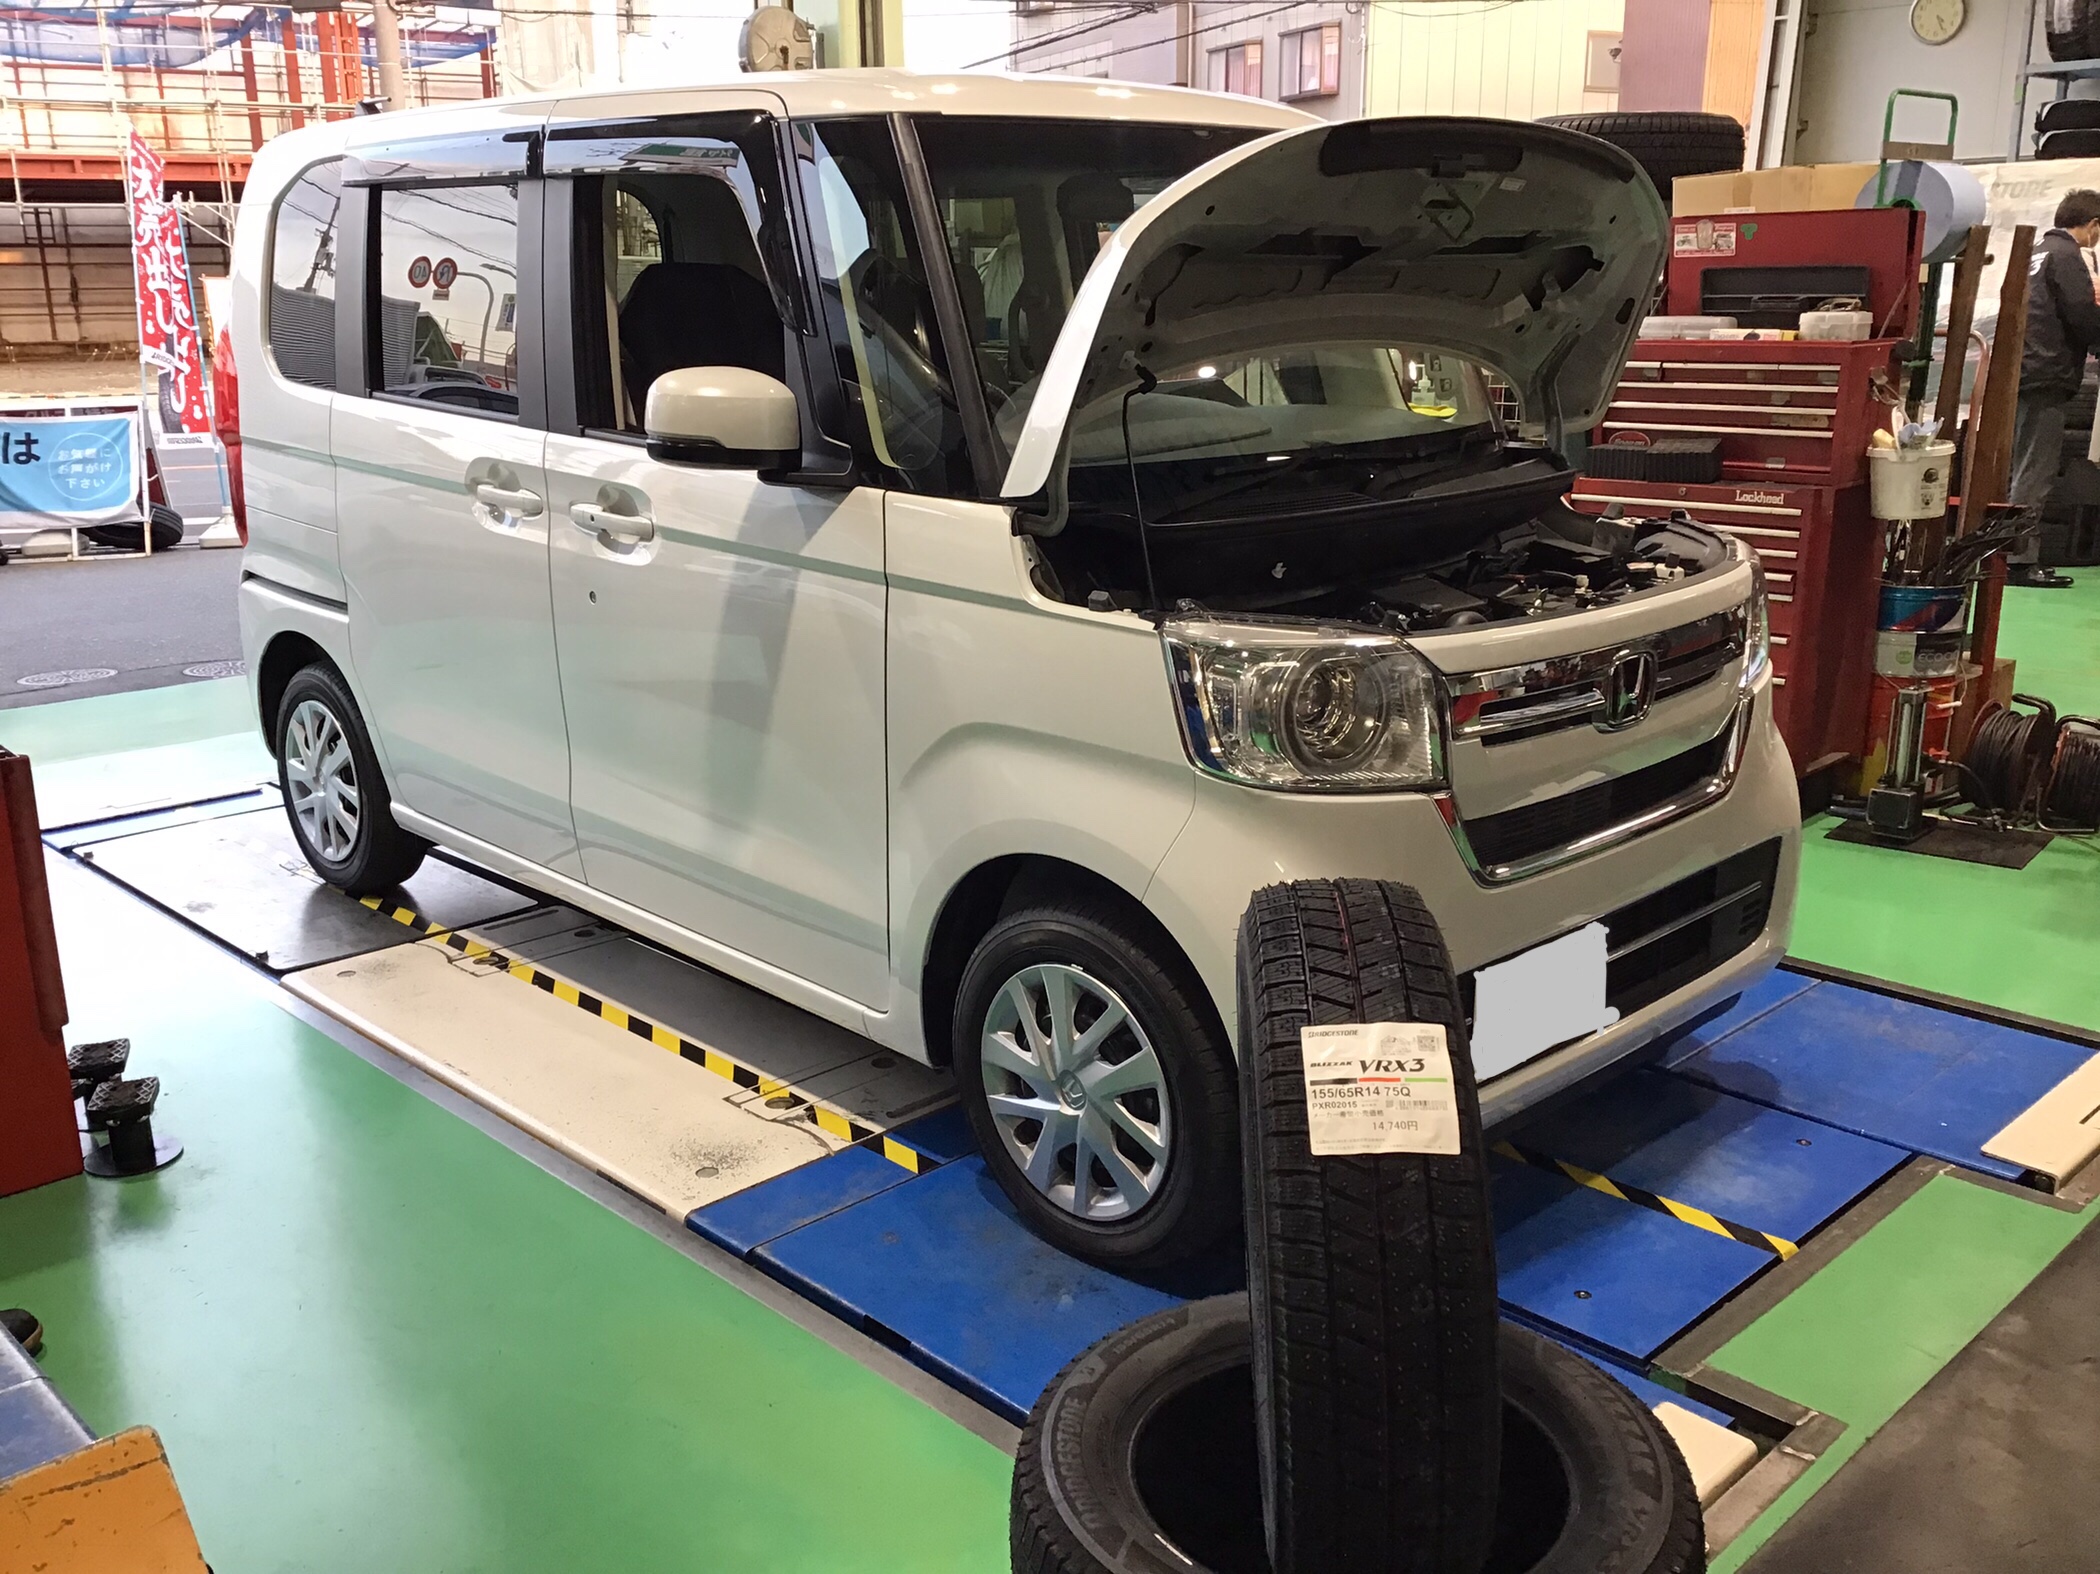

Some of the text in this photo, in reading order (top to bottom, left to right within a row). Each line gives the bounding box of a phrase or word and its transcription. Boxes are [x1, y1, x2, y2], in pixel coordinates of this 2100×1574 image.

[131, 155, 177, 334] 大売出し
[2, 431, 41, 465] は
[65, 477, 105, 489] 下さい
[1308, 1029, 1359, 1039] BRIDGESTONE
[1310, 1058, 1425, 1074] BLIZZAK VRX3
[1311, 1086, 1411, 1100] 155/65R14 75Q
[1312, 1101, 1358, 1110] PXR02015
[1372, 1120, 1418, 1131] 14,740円
